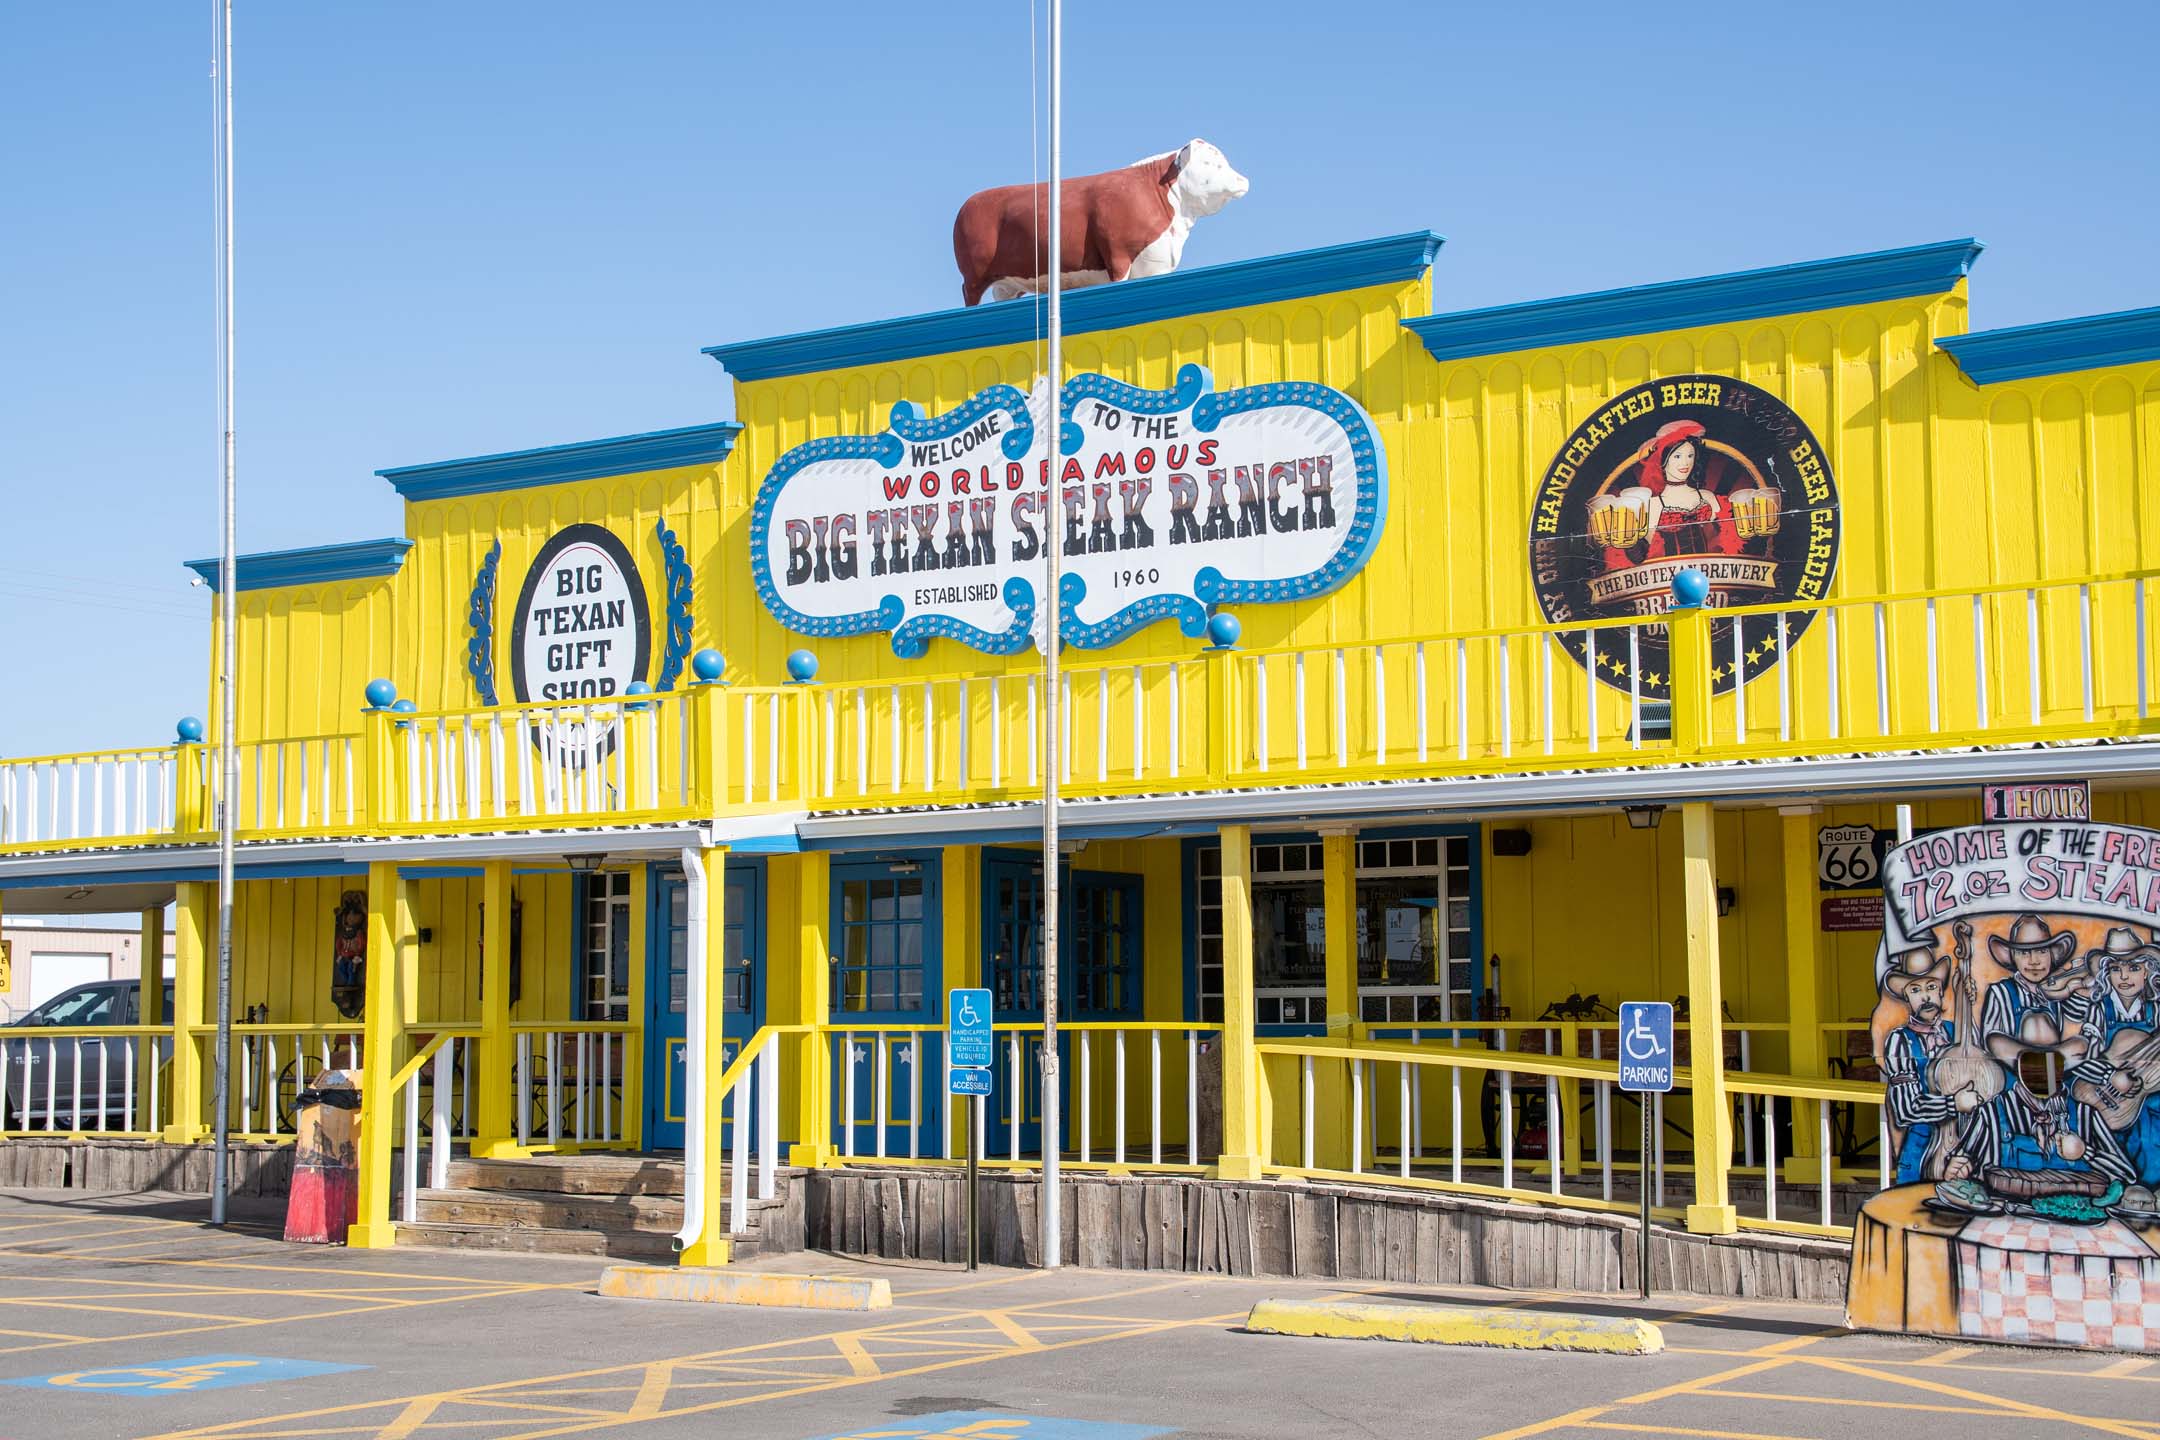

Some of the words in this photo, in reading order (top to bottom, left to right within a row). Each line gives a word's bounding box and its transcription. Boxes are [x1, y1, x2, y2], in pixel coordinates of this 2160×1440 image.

[1660, 383, 1722, 408] BEER
[911, 413, 1001, 467] WELCOME
[1094, 403, 1121, 430] TO
[1131, 416, 1179, 440] THE
[883, 462, 1024, 501] WORLD
[1790, 439, 1831, 505] BEER
[785, 513, 859, 586] BIG
[866, 496, 997, 577] TEXAN
[1168, 454, 1337, 545] RANCH
[556, 565, 602, 597] BIG
[915, 583, 998, 605] ESTABLISHED
[1113, 568, 1160, 589] 1960
[1594, 576, 1622, 597] THE
[1623, 571, 1649, 589] BIG
[1650, 564, 1697, 584] TEX
[1700, 563, 1771, 582] BREWERY
[534, 600, 626, 637] TEXAN
[1634, 591, 1729, 615] BREED
[547, 639, 612, 672] GIFT
[542, 677, 616, 710] SHOP
[1992, 788, 2008, 819] 1
[2013, 787, 2086, 819] HOUR
[1825, 830, 1867, 842] ROUTE
[1905, 829, 2008, 877] HOME
[2019, 828, 2051, 856] OF
[2059, 828, 2100, 857] THE
[1825, 846, 1870, 880] 66
[952, 1081, 989, 1091] ACCESSIBLE
[965, 1073, 978, 1082] VAN
[1623, 1066, 1668, 1083] PARKING
